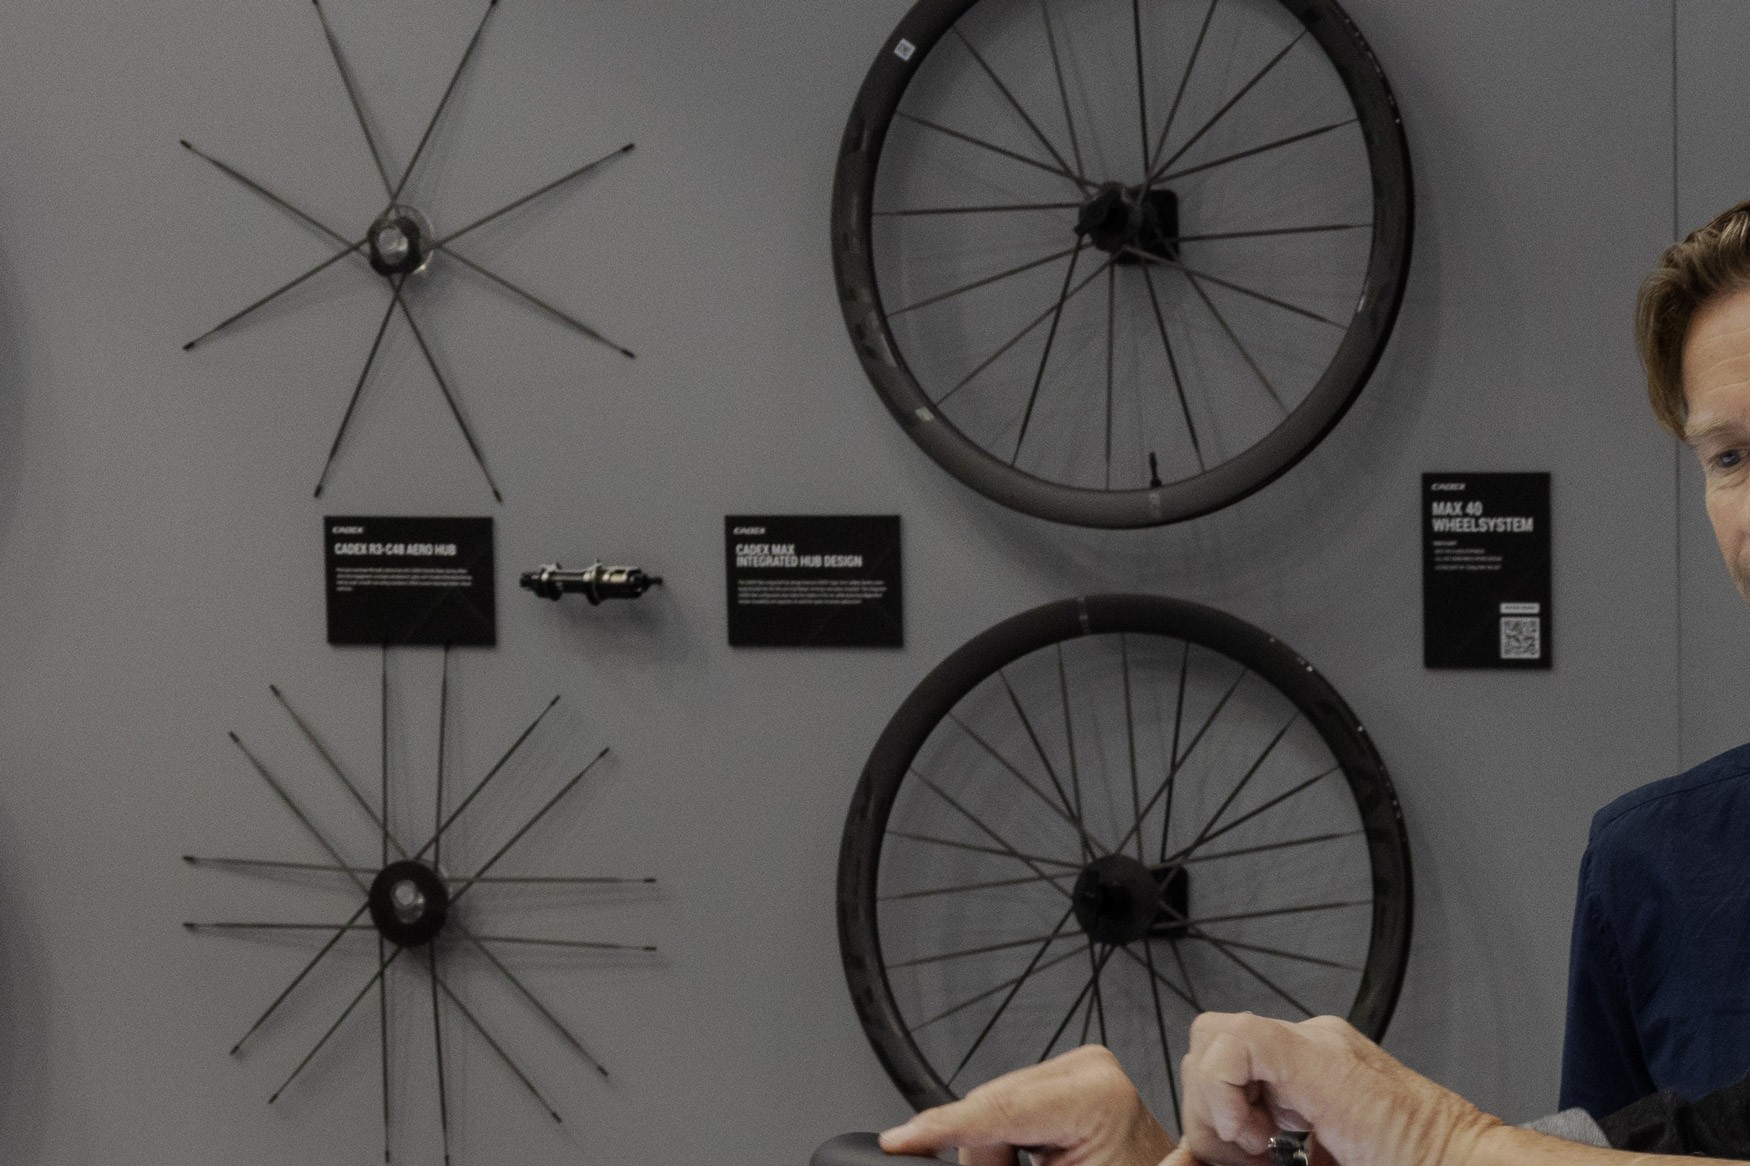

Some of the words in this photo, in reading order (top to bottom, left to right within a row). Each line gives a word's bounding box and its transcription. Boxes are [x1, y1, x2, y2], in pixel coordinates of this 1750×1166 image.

[1432, 501, 1462, 516] MAX
[1465, 501, 1483, 516] 40
[1432, 517, 1533, 532] WHEELSYSTEM
[334, 543, 367, 555] CADEX
[406, 543, 434, 556] AERO
[434, 543, 457, 557] HUB
[735, 543, 770, 555] CADEX
[771, 543, 795, 555] MAX
[736, 555, 798, 567] INTEGRATED
[800, 555, 822, 567] HUB
[824, 555, 863, 567] DESIGN
